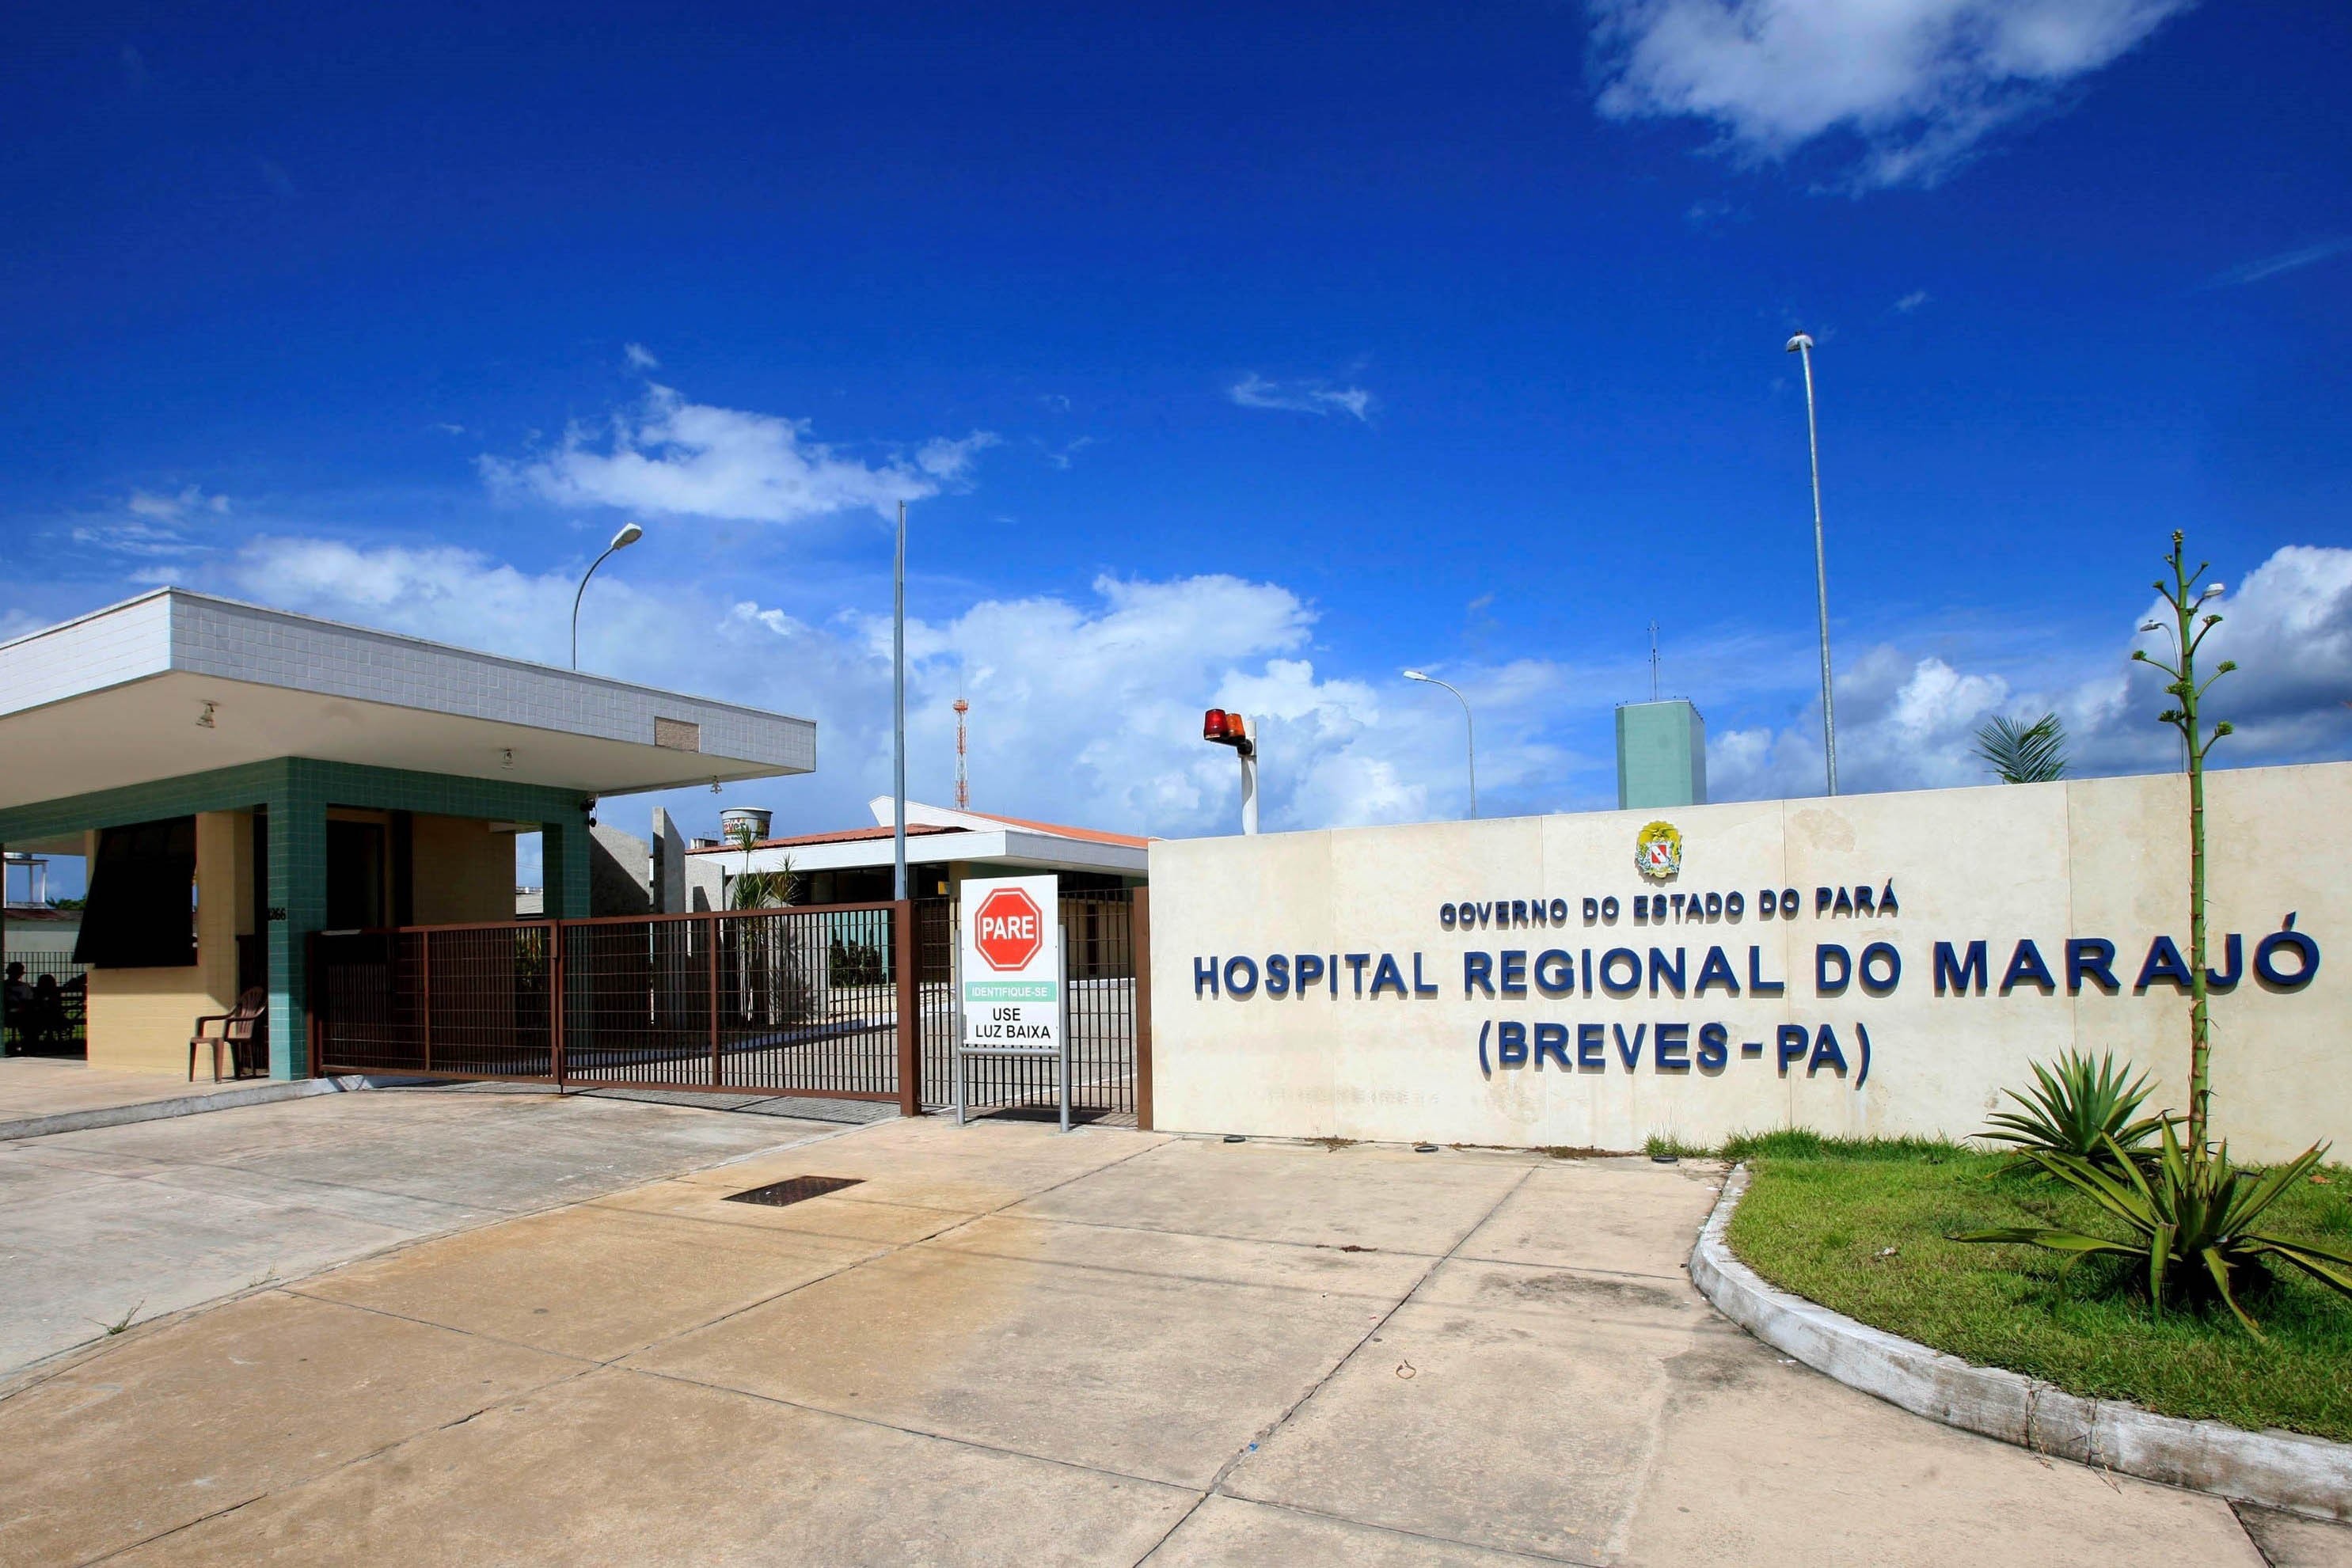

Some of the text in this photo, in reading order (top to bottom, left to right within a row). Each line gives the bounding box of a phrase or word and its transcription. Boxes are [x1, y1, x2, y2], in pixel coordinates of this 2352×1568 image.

[1440, 878, 1899, 924] GOVERNO DO ESTADO DO PARÁ
[982, 915, 1035, 940] PARE
[1194, 912, 2320, 995] HOSPITAL REGIONAL DO MARAJÓ
[972, 986, 1048, 997] IDENTIFIQUE-SE
[993, 1008, 1021, 1021] USE
[975, 1024, 1051, 1039] LUZ BAIXA
